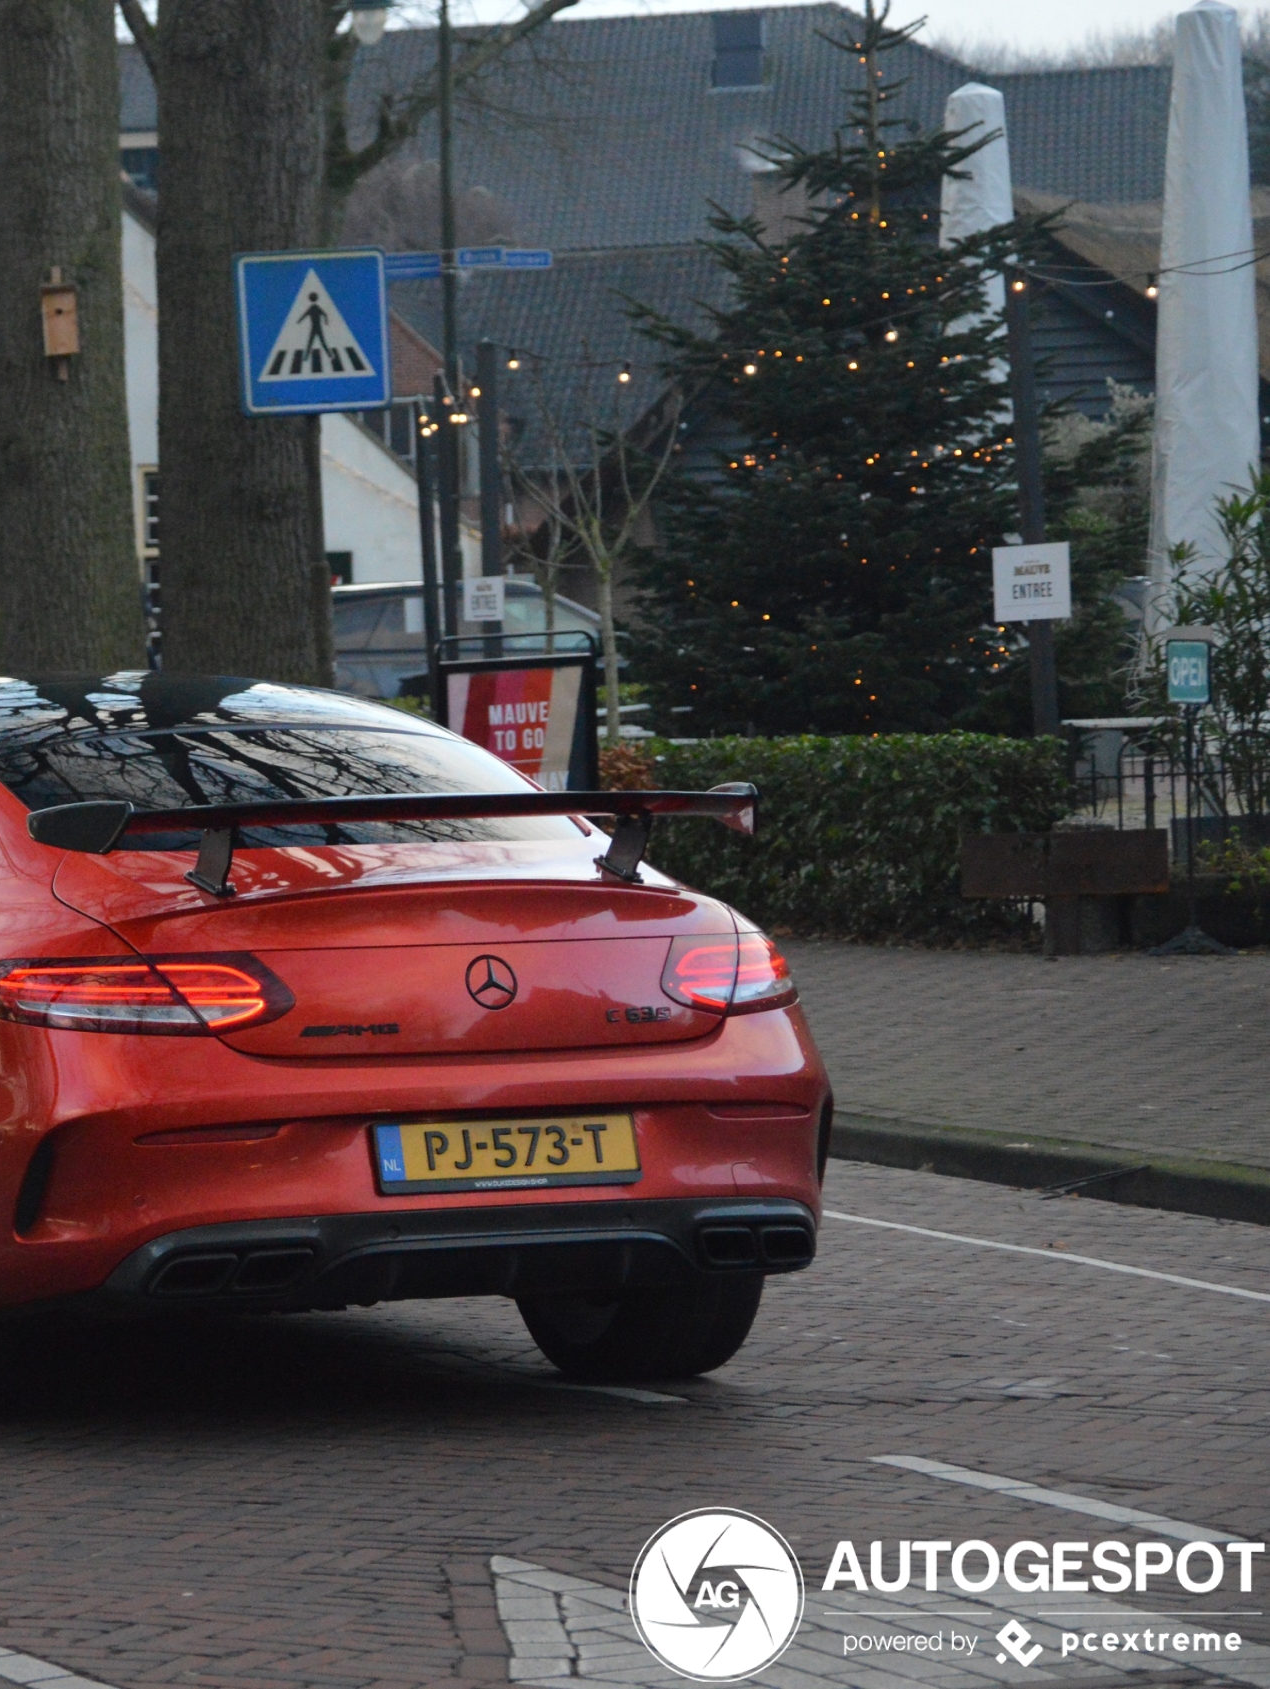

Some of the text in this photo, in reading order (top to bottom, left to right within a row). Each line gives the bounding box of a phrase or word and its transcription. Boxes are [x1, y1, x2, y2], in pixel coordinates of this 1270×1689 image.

[1012, 582, 1053, 600] ENTREE
[1170, 657, 1207, 687] OPEN
[488, 701, 549, 726] MAUVE
[494, 727, 545, 751] TO GO
[607, 1008, 620, 1022] C
[332, 1023, 400, 1037] AMG
[424, 1123, 607, 1171] PJ-573-T
[383, 1159, 401, 1172] NL
